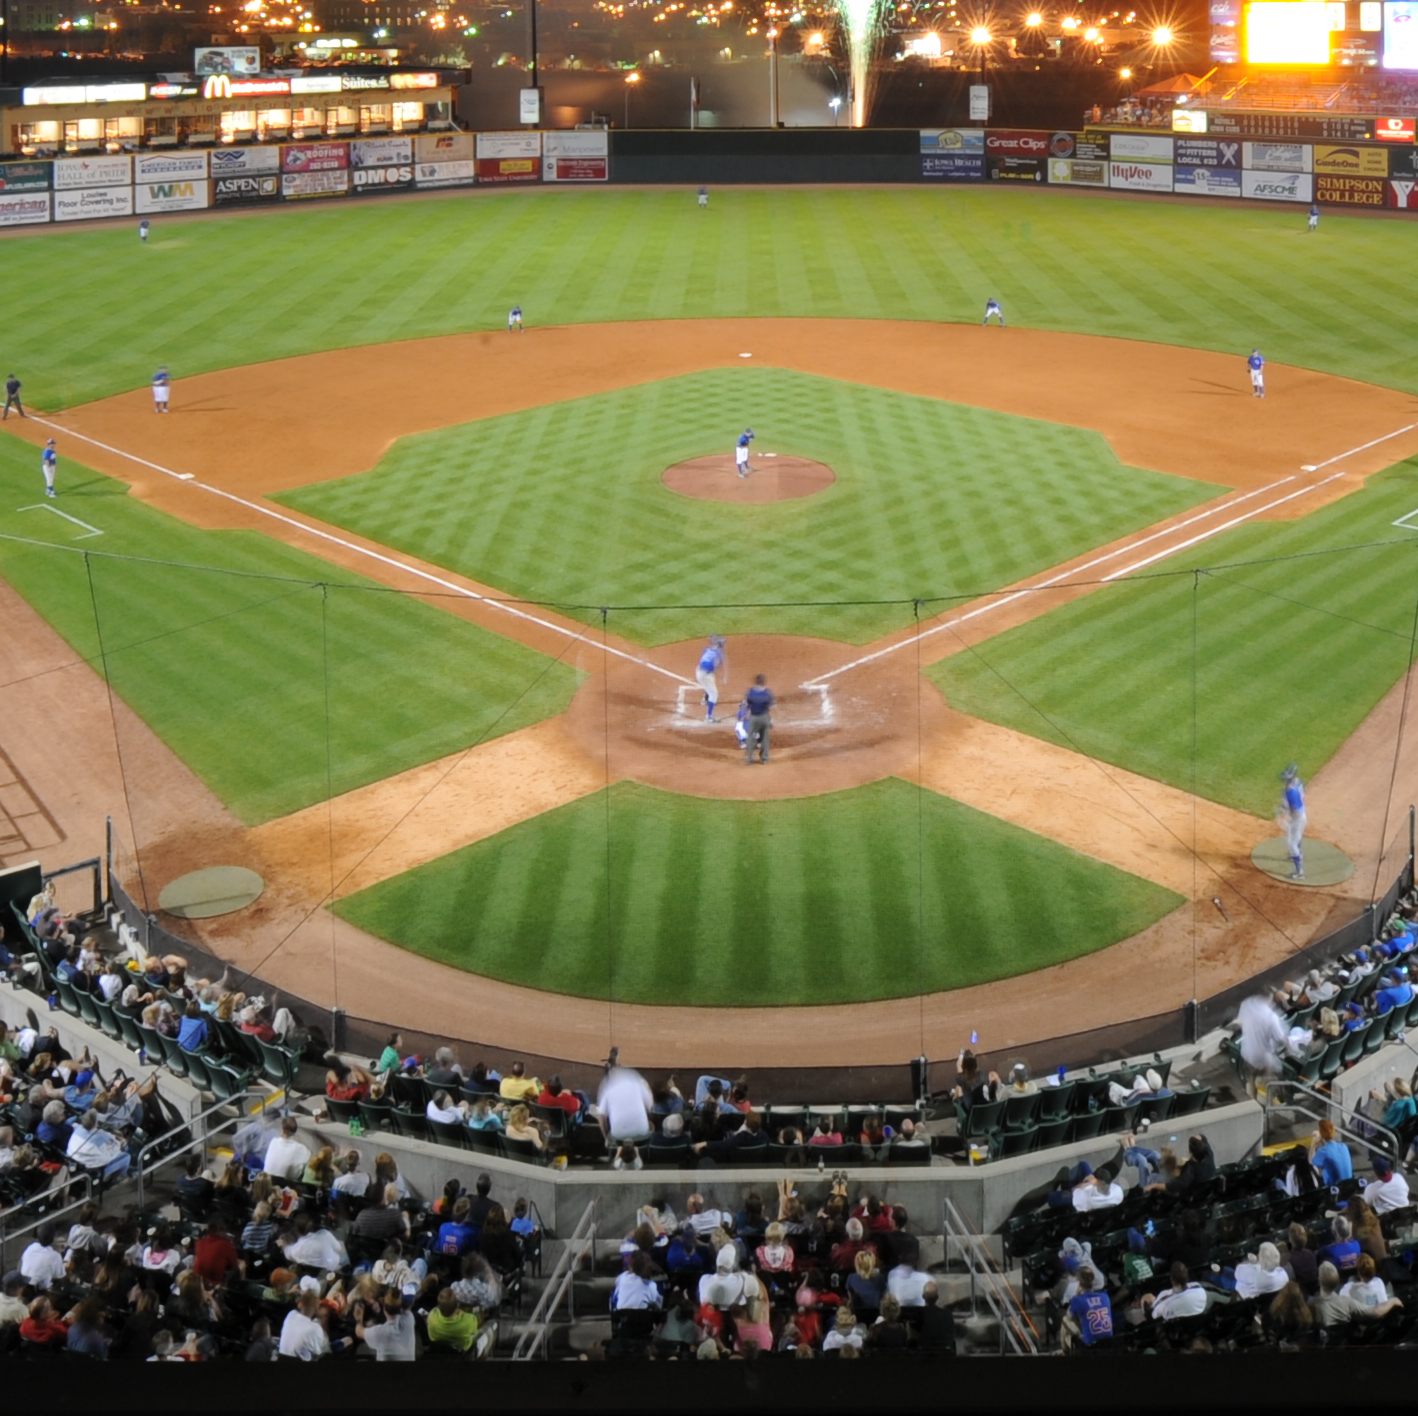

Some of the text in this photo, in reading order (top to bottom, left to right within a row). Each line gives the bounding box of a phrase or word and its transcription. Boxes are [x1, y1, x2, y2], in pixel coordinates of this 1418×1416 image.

[986, 136, 1045, 150] Great Clips
[1177, 140, 1217, 148] PLUMBERS
[306, 149, 344, 159] ROOFING
[562, 145, 605, 154] Manpower
[57, 163, 84, 172] IOWA
[1315, 158, 1360, 168] GuideOne
[57, 168, 127, 181] HALL of PRIDE
[353, 166, 412, 185] DMOS
[216, 177, 259, 193] ASPEN
[1254, 184, 1298, 195] AFSCME
[1317, 178, 1383, 191] SIMPSON
[79, 198, 114, 207] Covering
[1316, 190, 1382, 204] COLLEGE
[1086, 1296, 1102, 1307] LEE
[1086, 1307, 1112, 1335] 25
